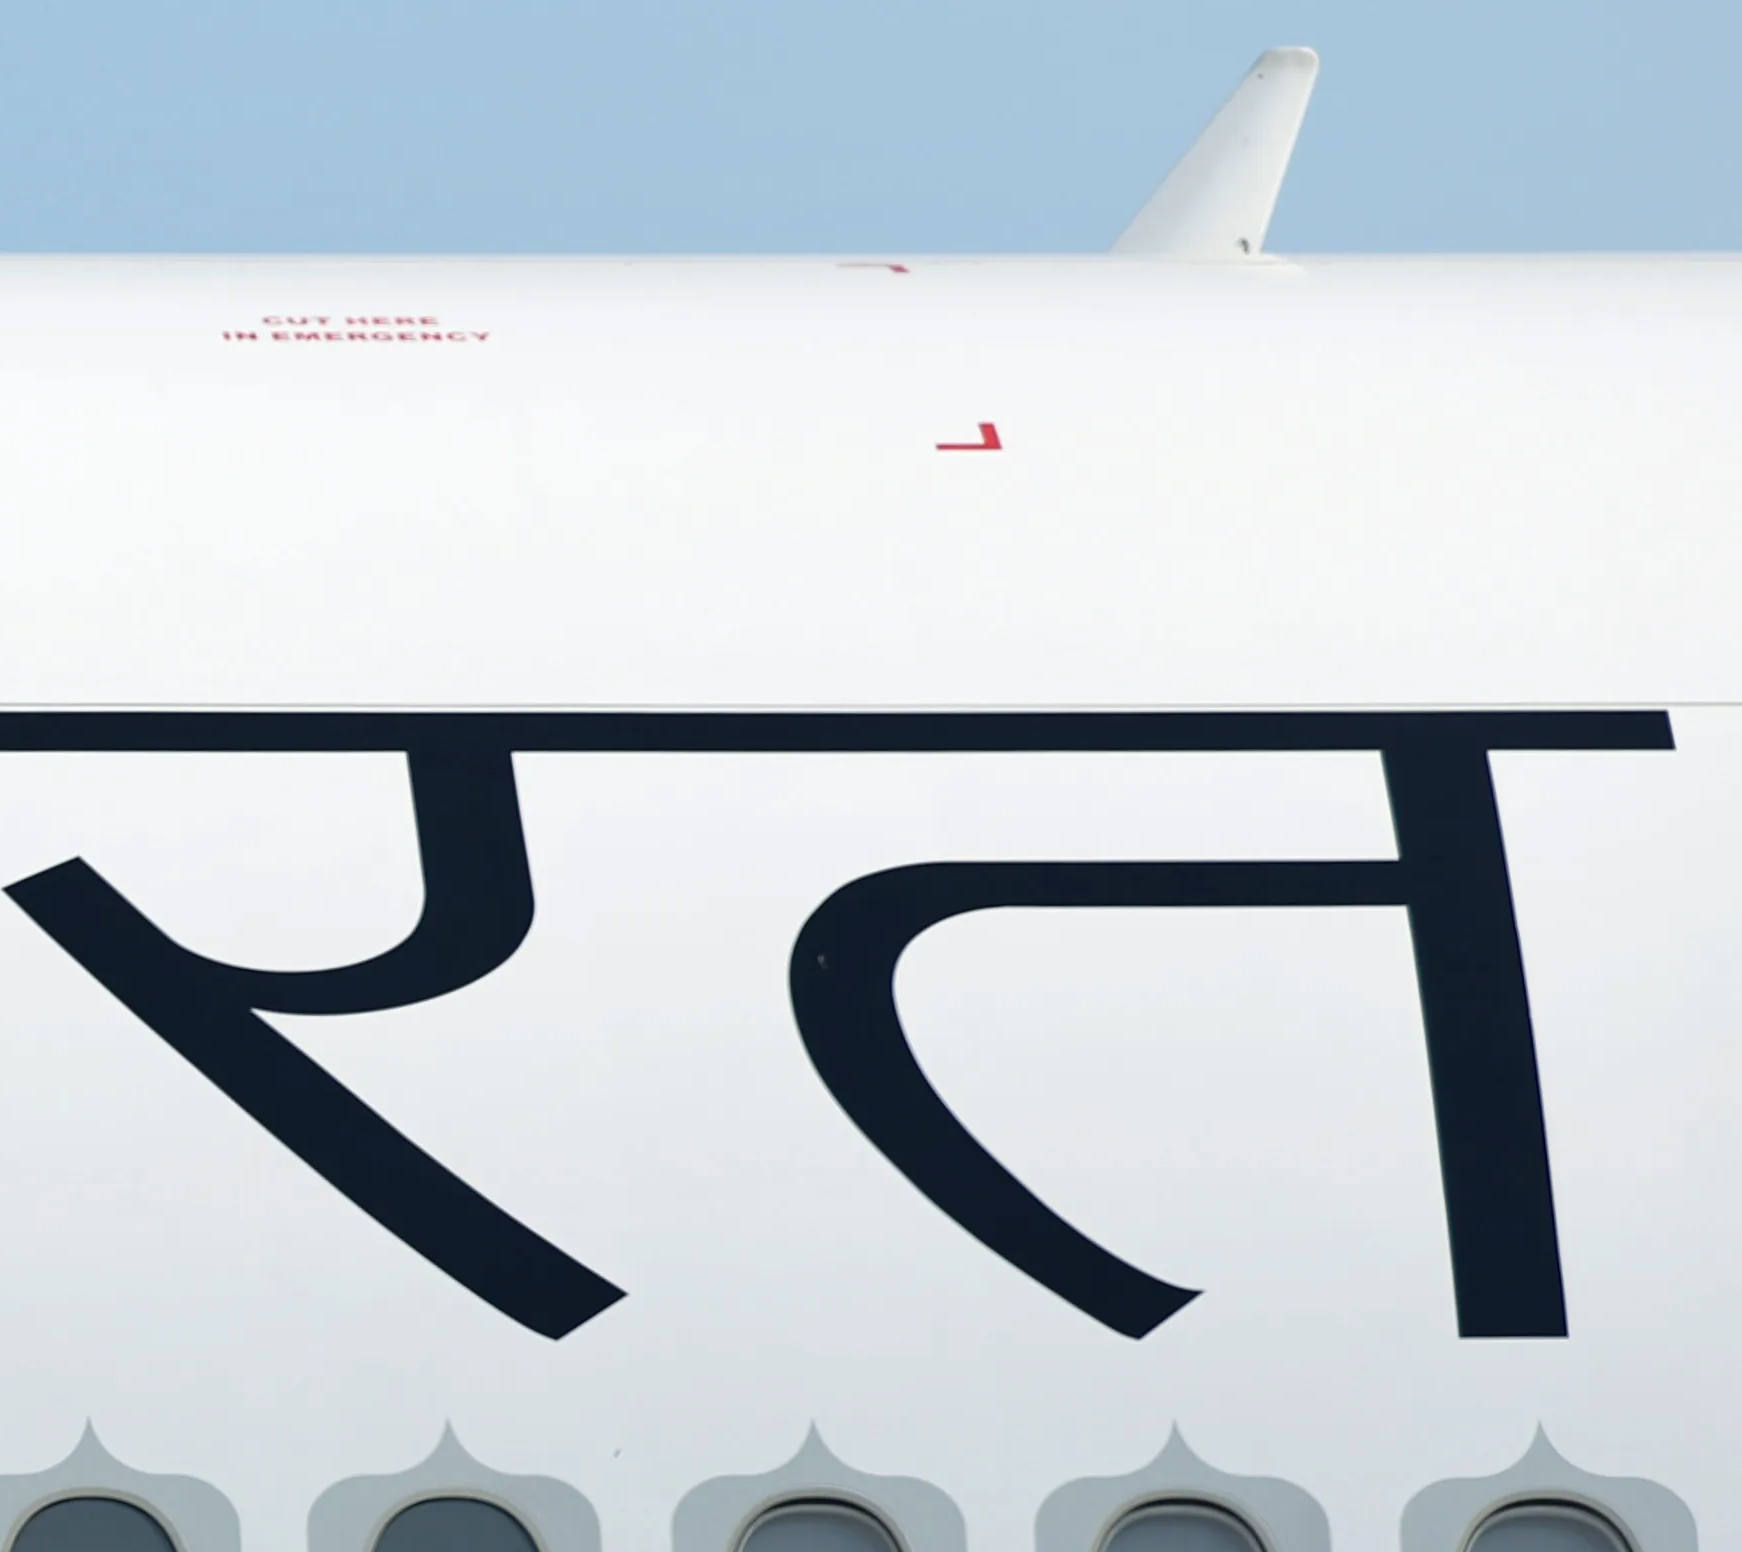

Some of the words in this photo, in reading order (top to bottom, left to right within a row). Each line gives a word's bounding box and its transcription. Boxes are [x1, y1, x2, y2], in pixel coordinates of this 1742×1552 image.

[262, 315, 331, 325] CUT
[345, 315, 439, 325] HERE
[221, 331, 258, 341] IN
[271, 331, 490, 341] EMERGENCY
